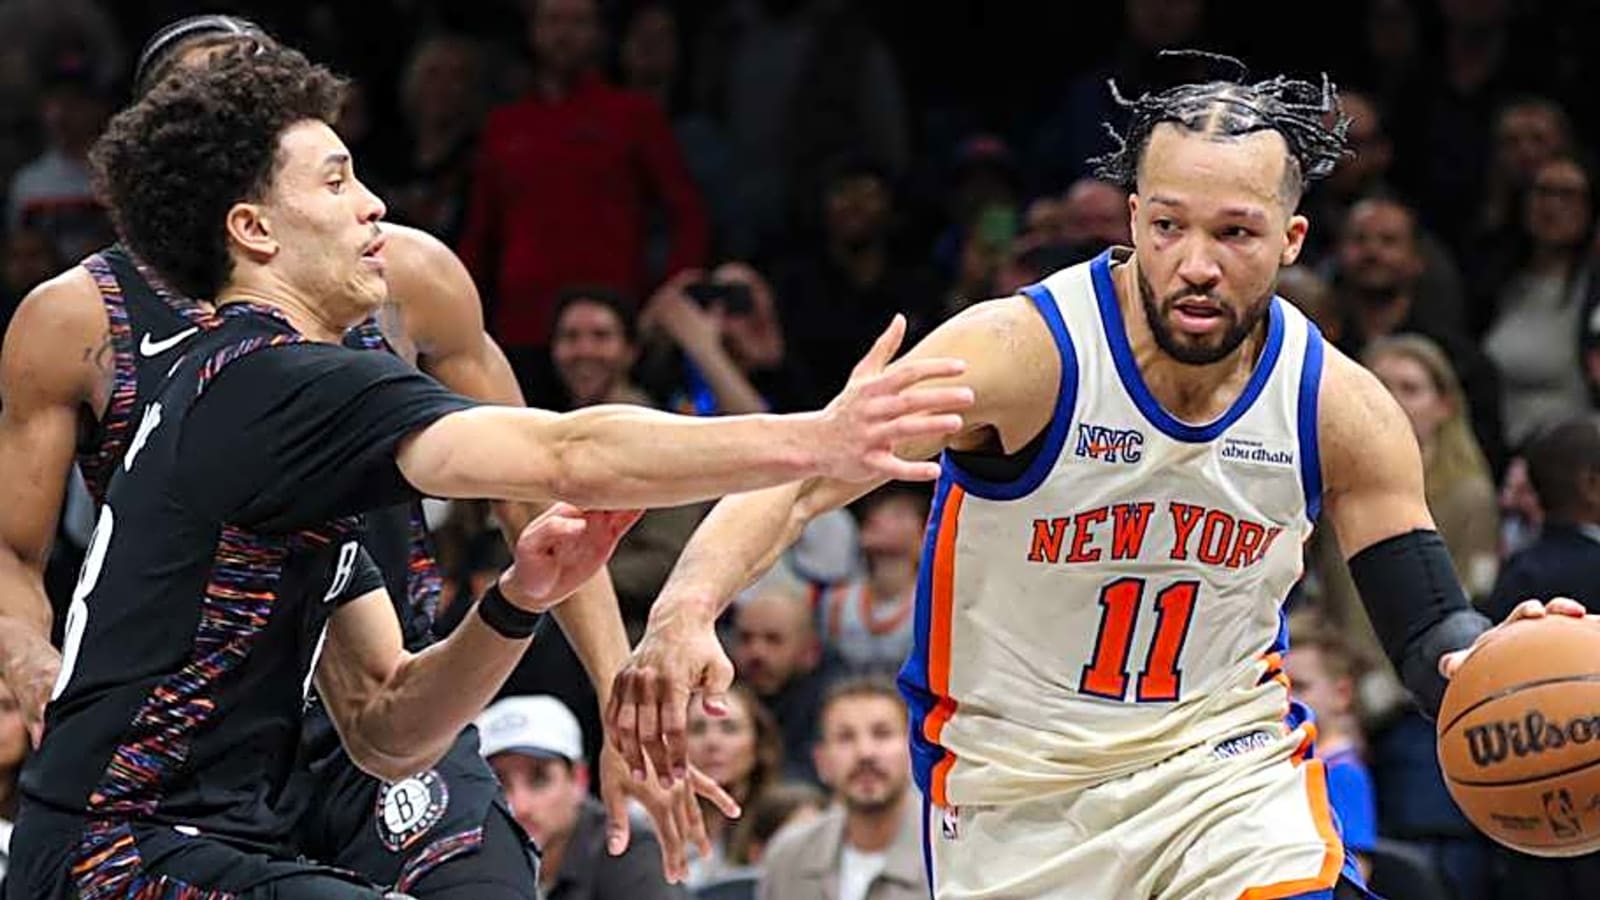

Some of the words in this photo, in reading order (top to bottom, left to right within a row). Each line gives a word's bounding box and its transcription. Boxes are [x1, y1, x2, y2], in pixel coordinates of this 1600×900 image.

[1076, 424, 1144, 464] NYC
[1222, 446, 1250, 460] abu
[1251, 448, 1294, 465] dhabi
[1028, 502, 1155, 564] NEW
[1078, 577, 1200, 702] 11
[394, 788, 413, 824] B
